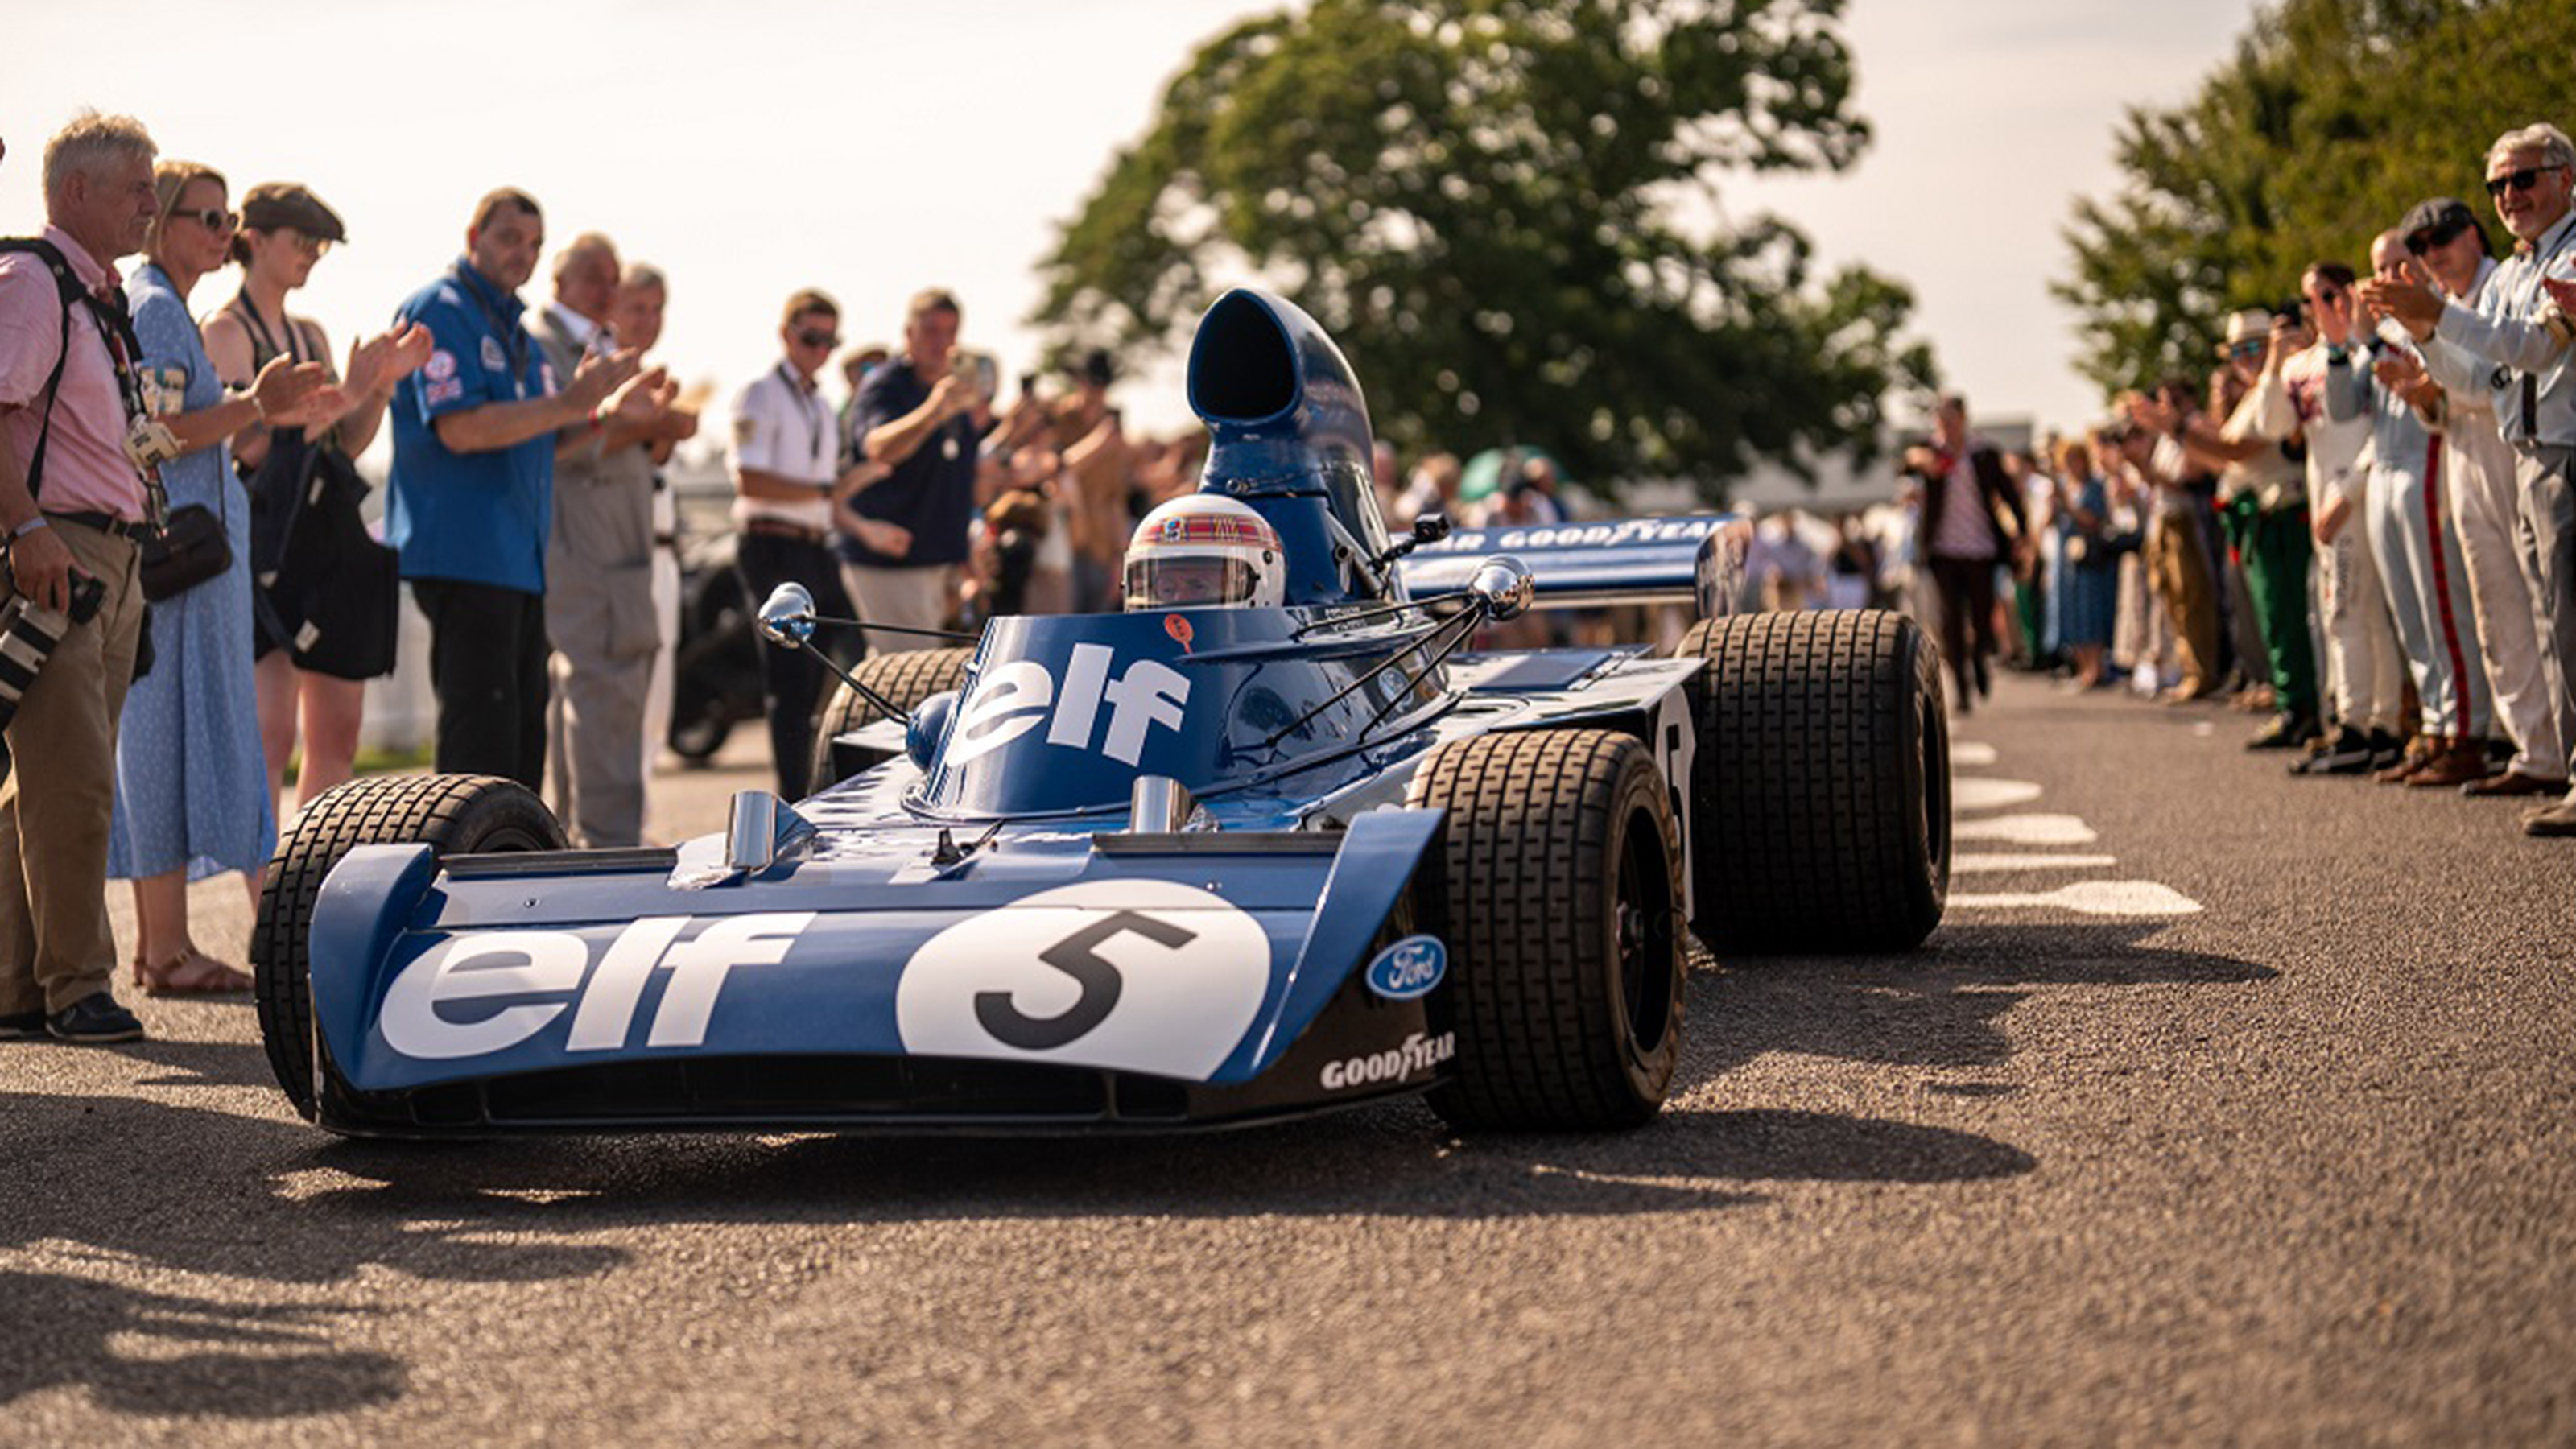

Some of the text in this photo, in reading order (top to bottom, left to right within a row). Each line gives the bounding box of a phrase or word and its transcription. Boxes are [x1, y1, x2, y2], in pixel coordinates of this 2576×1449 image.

[945, 643, 1191, 767] elf
[379, 912, 816, 1059] elf
[973, 910, 1198, 1051] 5
[1389, 944, 1435, 989] Ford
[1320, 1030, 1455, 1090] GOODYEAR
